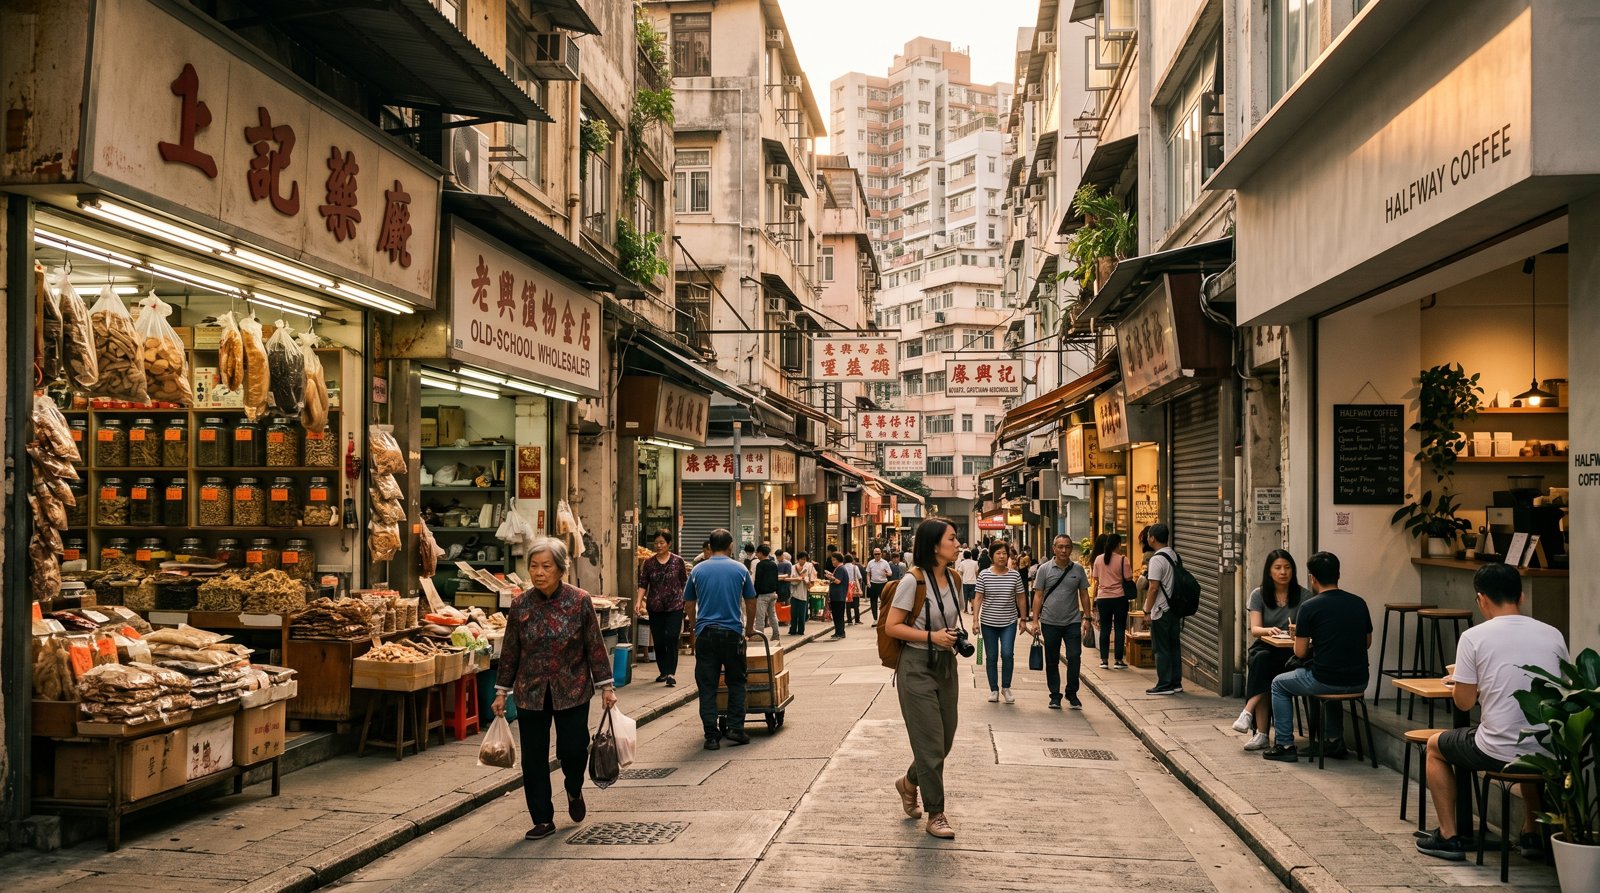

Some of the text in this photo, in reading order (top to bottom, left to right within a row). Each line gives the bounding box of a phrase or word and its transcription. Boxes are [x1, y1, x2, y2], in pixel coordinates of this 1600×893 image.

[1385, 123, 1512, 223] HALFWAY COFFEE
[470, 319, 591, 378] OLD-SCHOOL WHOLESALER
[1340, 409, 1399, 417] HALFWAY COFFEE
[1578, 473, 1600, 487] COFF
